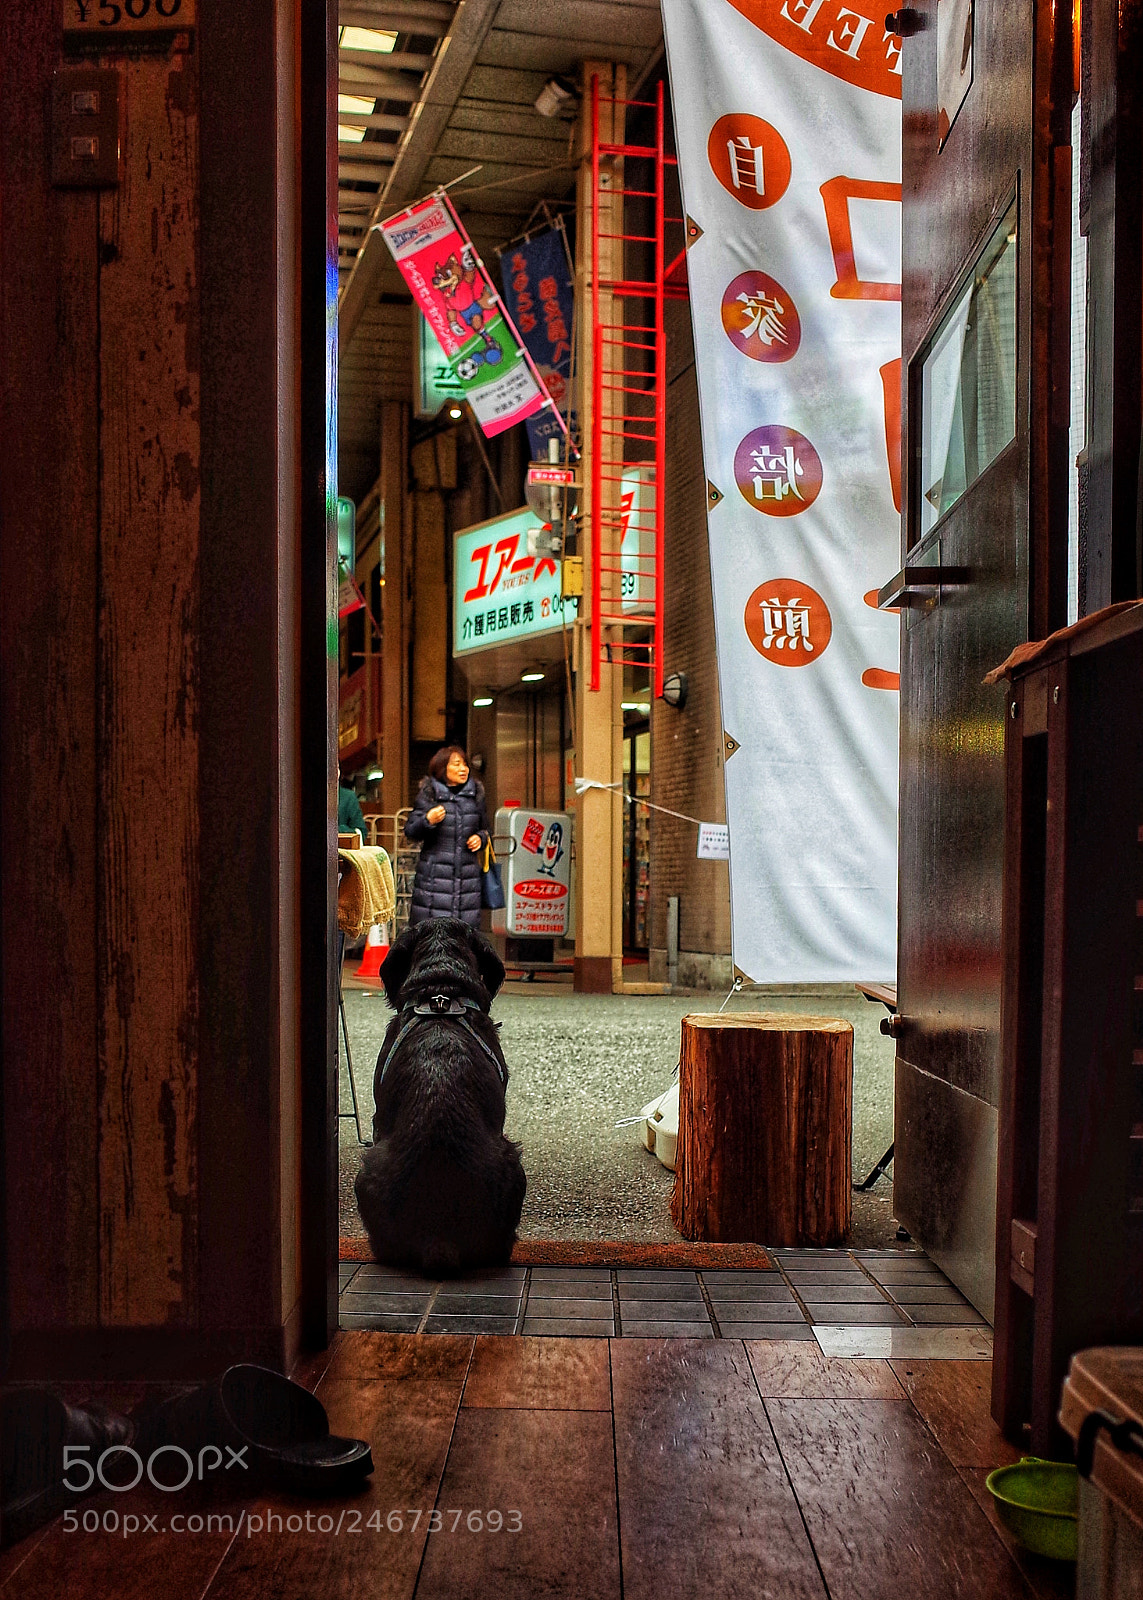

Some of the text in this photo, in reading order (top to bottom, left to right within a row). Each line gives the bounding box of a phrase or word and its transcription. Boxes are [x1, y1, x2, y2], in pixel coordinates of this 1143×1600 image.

[462, 601, 534, 640] 介護用品販売
